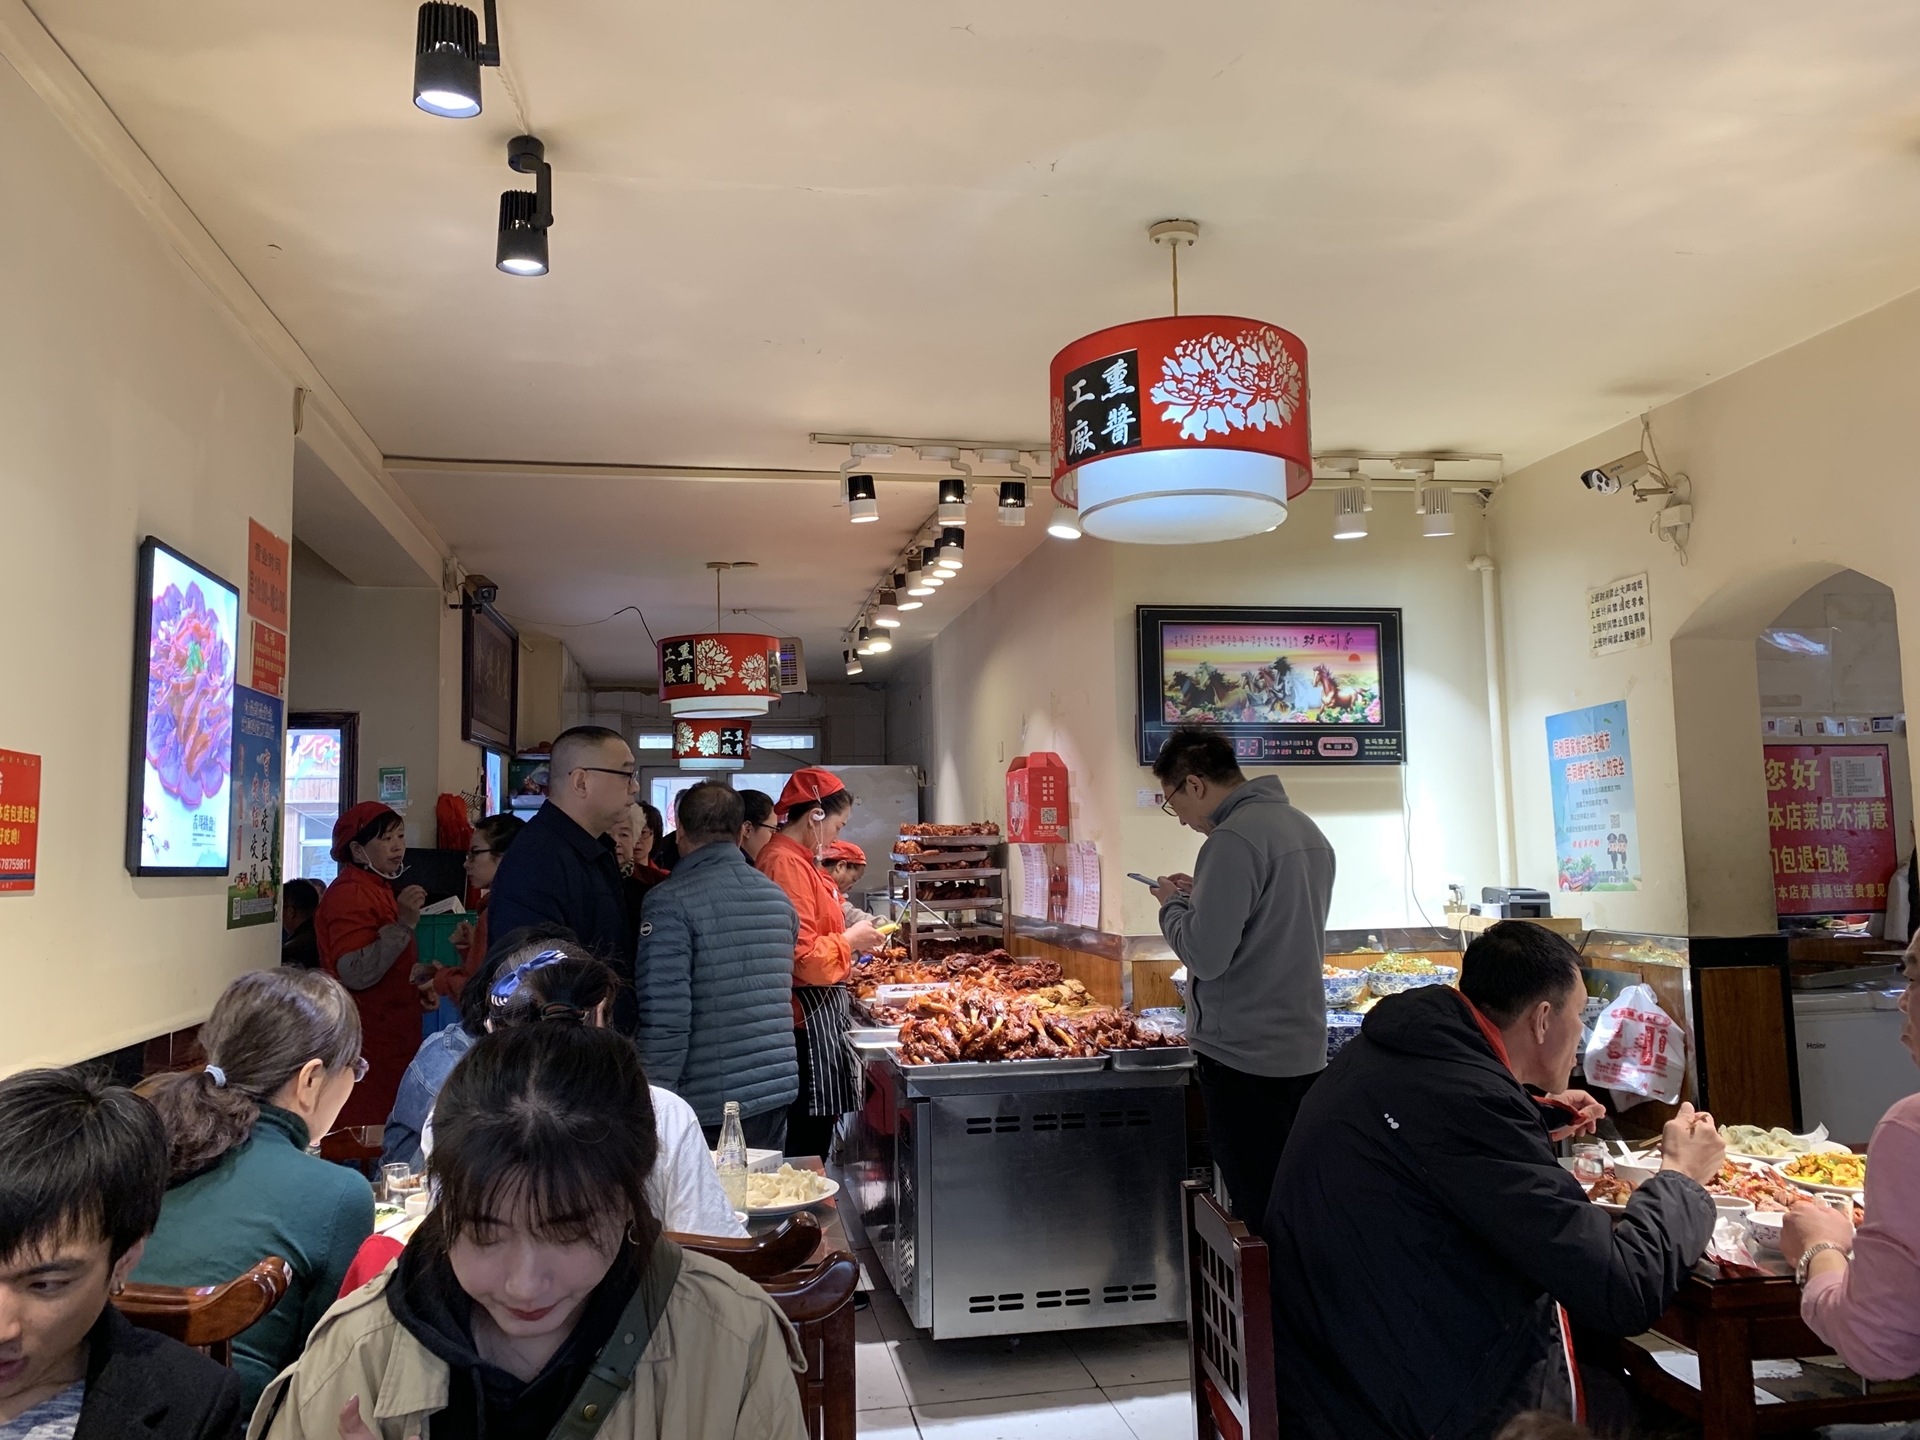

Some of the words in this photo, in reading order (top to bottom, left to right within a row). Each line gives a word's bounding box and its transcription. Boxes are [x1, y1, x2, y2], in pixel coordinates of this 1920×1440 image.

[1766, 758, 1821, 791] 您好
[1769, 802, 1889, 831] 本店菜品不满意
[1774, 883, 1887, 900] 本店发展提出宝贵意见
